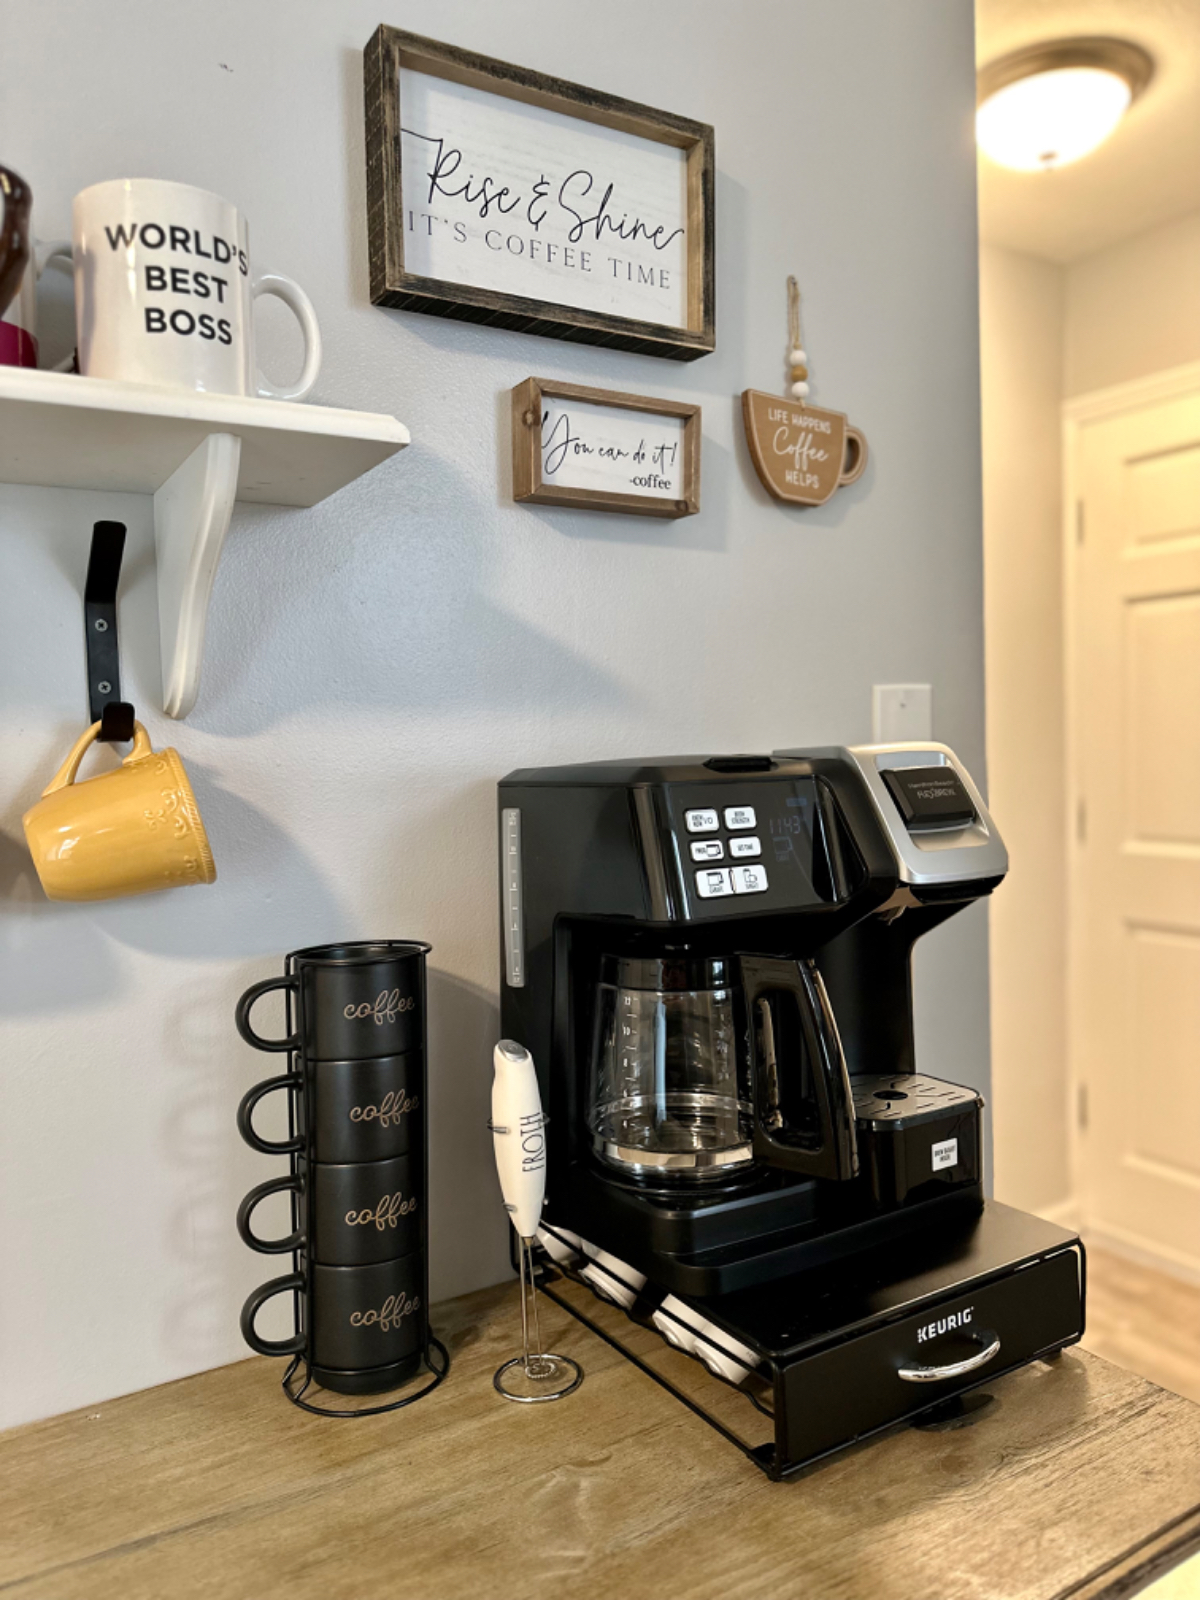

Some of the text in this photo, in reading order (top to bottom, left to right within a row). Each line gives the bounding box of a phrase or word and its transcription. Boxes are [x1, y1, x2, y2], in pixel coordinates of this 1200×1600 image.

[400, 128, 521, 218] Rise
[558, 170, 685, 250] Shine
[105, 222, 248, 277] WORLD'S
[408, 210, 671, 290] IT'S COFFEE TIME
[144, 265, 229, 303] BEST
[144, 306, 233, 346] BOSS
[767, 407, 832, 435] LIFE HAPPENS
[598, 445, 630, 461] can
[632, 438, 646, 465] do
[772, 426, 830, 471] Coffee
[785, 469, 820, 489] HELPS
[343, 988, 415, 1026] coffee
[349, 1088, 420, 1128] coffee
[519, 1111, 545, 1173] FROTH
[344, 1191, 418, 1232] coffee
[349, 1291, 421, 1333] coffee
[917, 1307, 973, 1344] KEURIG
